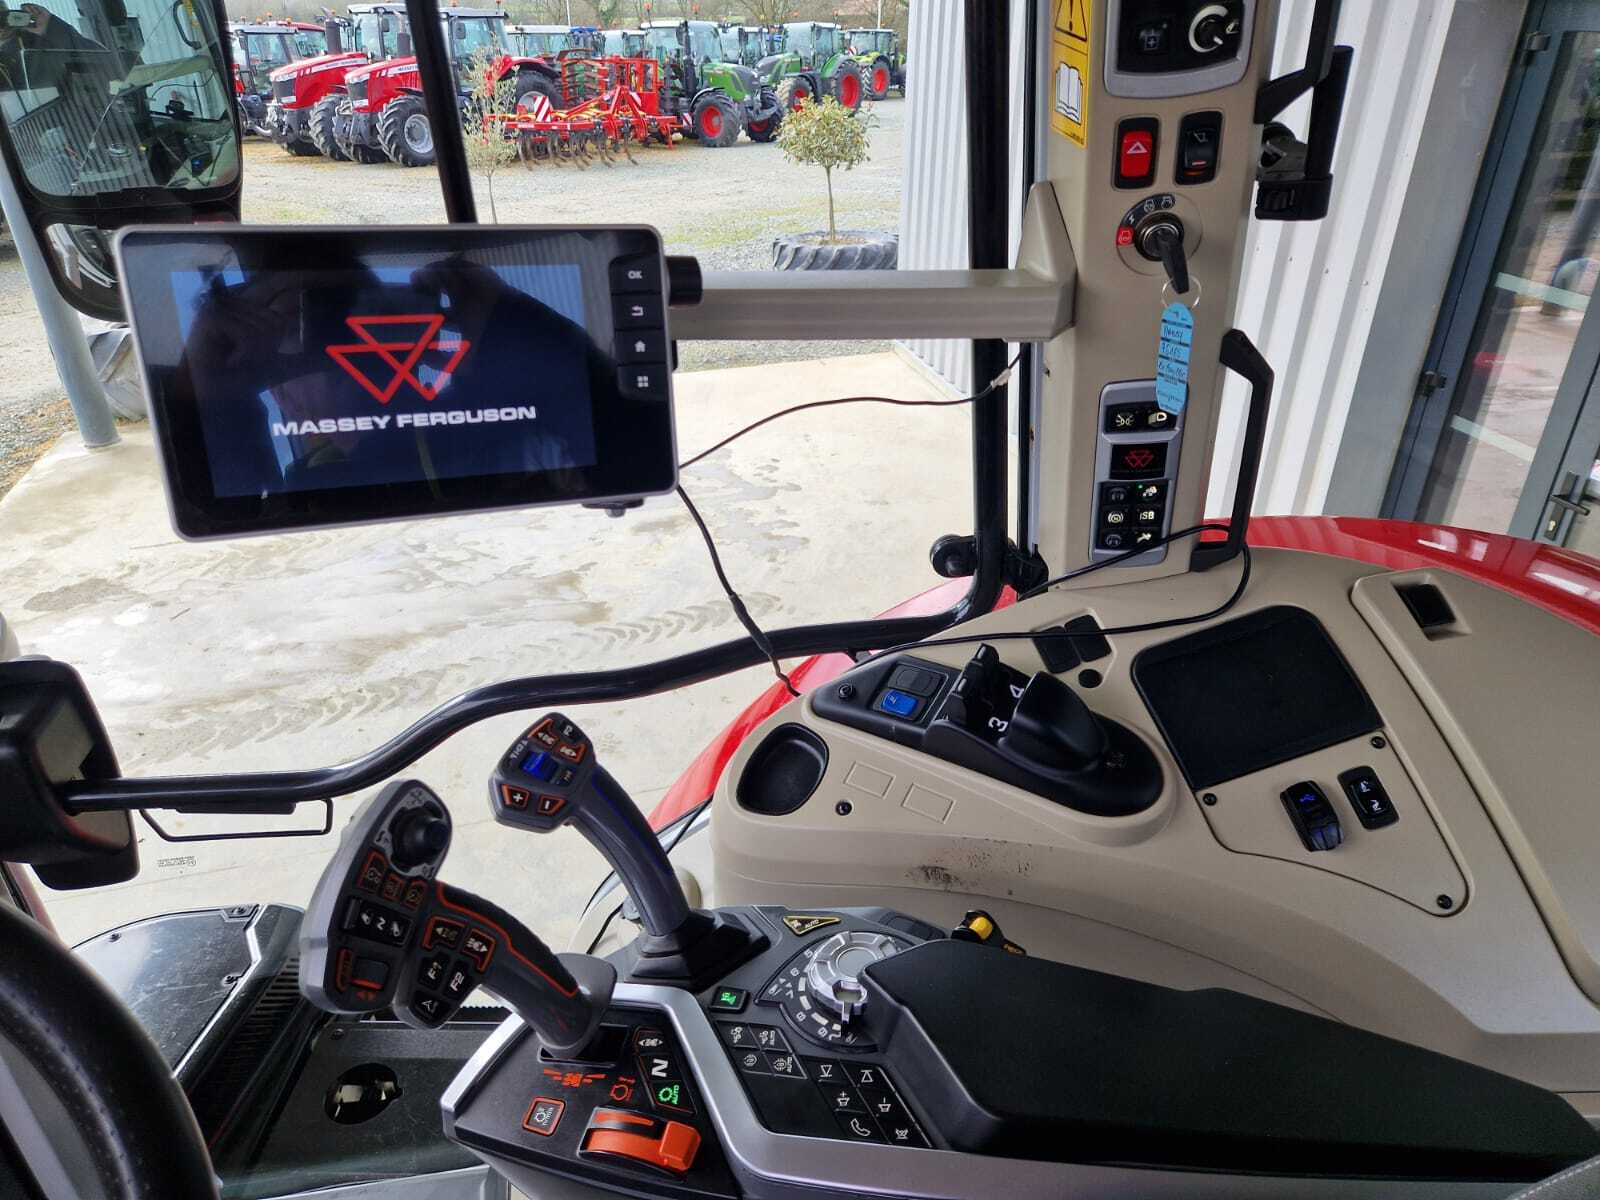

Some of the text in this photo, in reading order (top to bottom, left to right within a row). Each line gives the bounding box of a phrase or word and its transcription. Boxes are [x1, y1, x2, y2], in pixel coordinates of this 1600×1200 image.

[627, 270, 643, 279] OK
[272, 406, 537, 436] MASSEY FERGUSON
[1139, 510, 1155, 520] ISB
[1009, 684, 1025, 699] 4
[988, 716, 1009, 732] 3
[427, 961, 443, 980] F1
[450, 971, 465, 991] F2
[651, 1058, 669, 1078] N
[671, 1084, 680, 1105] AUTO
